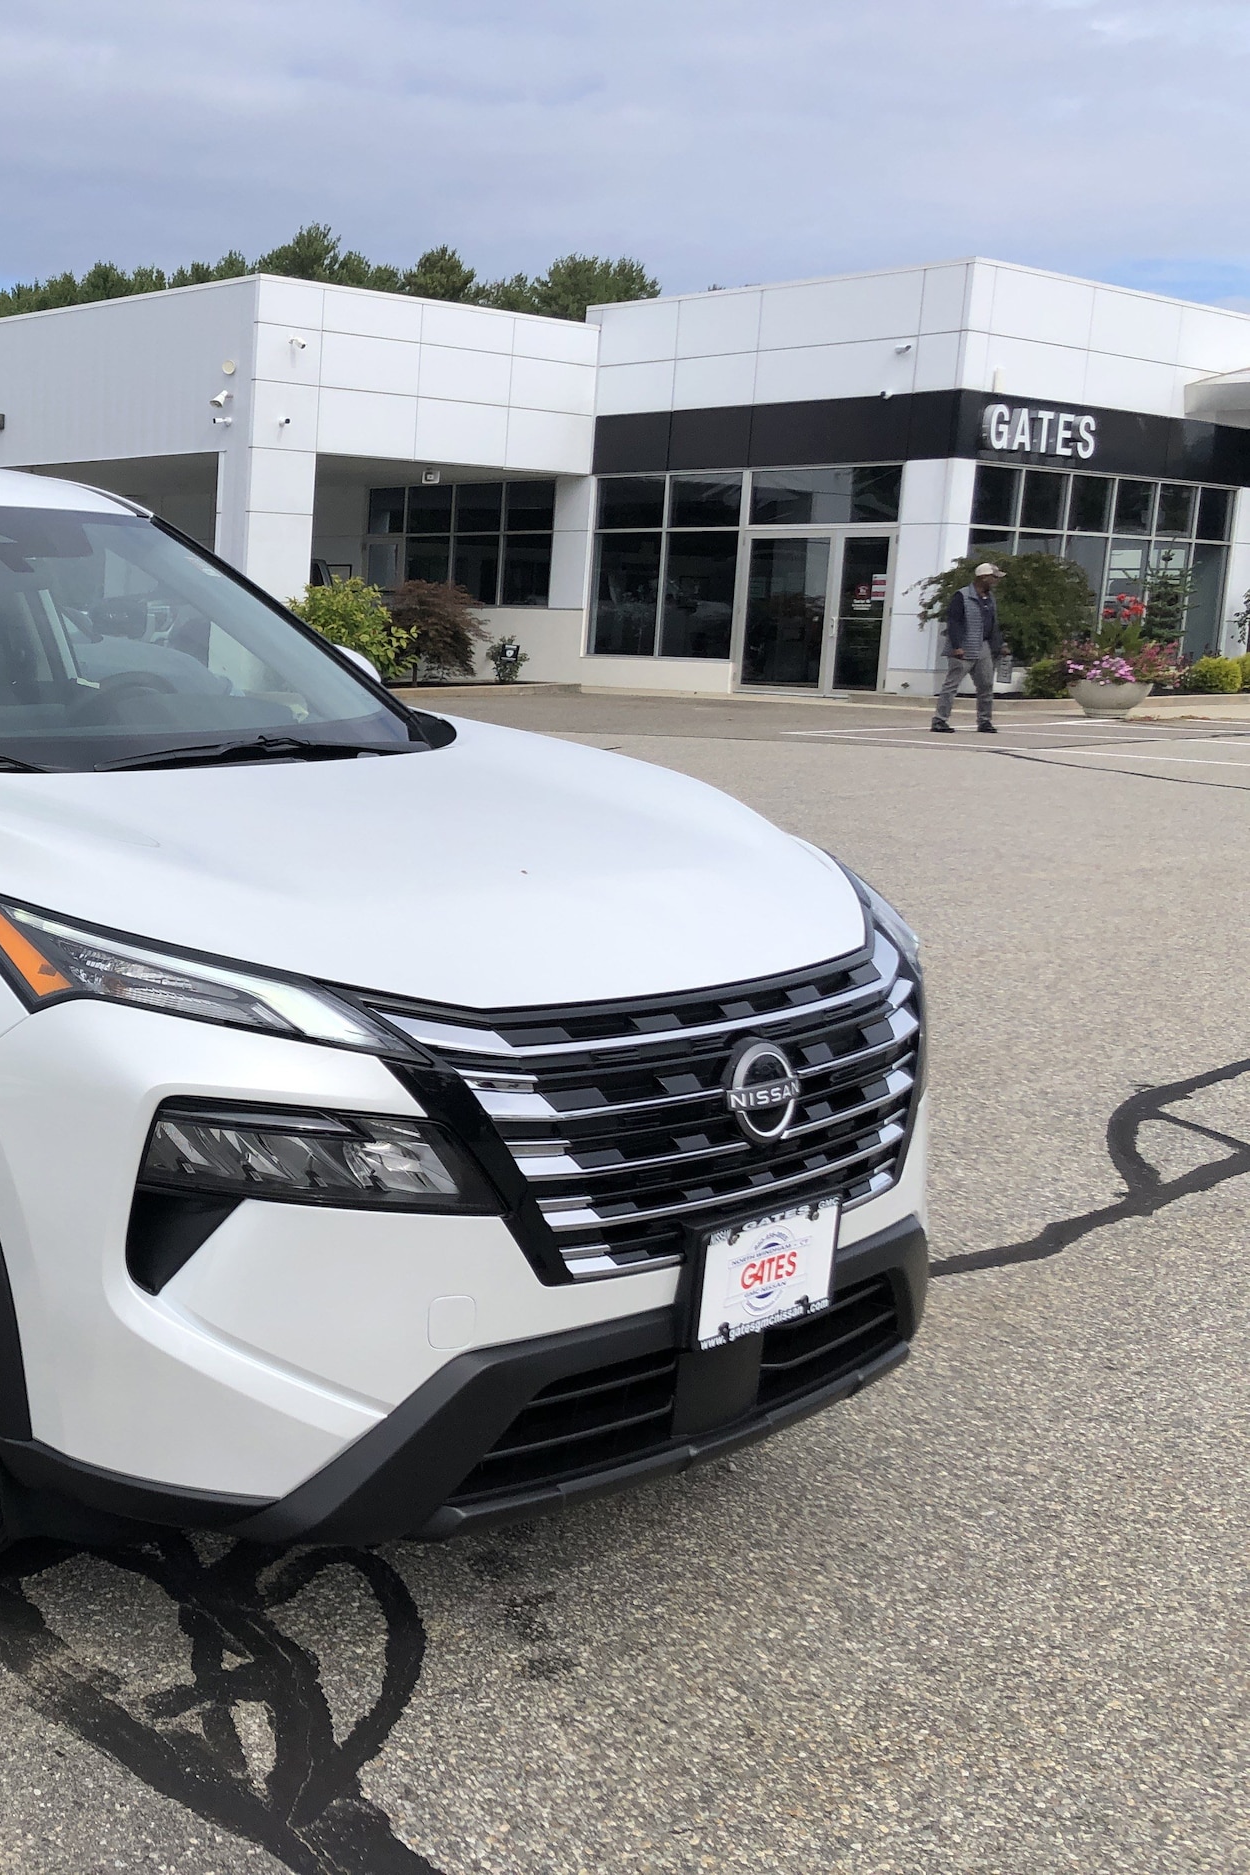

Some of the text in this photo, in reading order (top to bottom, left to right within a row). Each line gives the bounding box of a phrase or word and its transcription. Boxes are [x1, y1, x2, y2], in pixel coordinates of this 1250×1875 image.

[986, 403, 1096, 459] GATES
[730, 1080, 801, 1109] NISSAN
[742, 1204, 812, 1232] GATES
[740, 1251, 798, 1290] GATES
